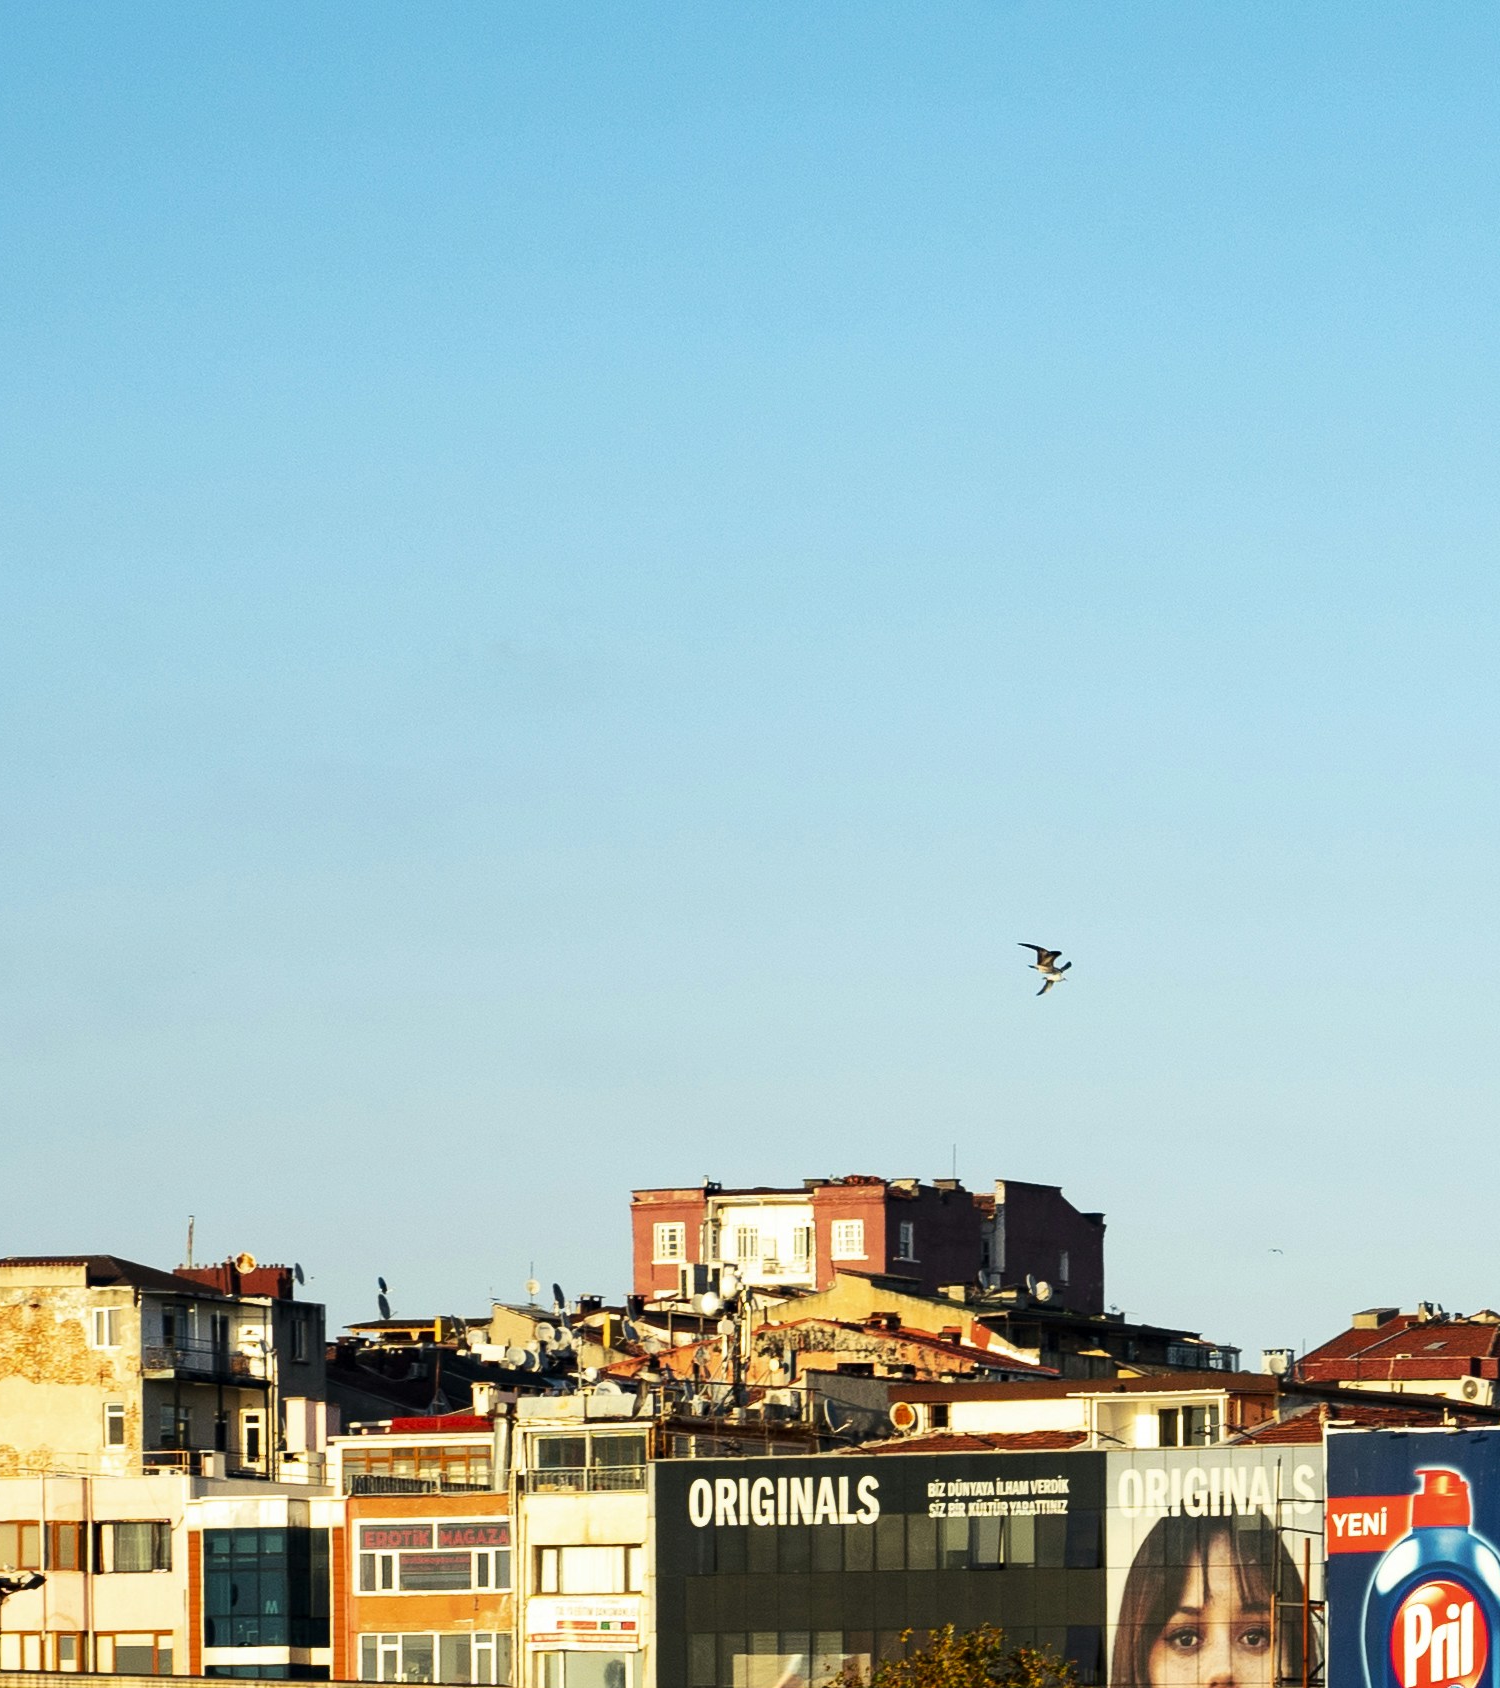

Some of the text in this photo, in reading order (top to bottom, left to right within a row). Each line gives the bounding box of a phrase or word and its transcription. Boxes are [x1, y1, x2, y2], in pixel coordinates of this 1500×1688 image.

[688, 1475, 880, 1527] ORIGINALS
[927, 1475, 1070, 1497] BİZ DÜNYAYA İLHAM VERDİK
[1118, 1464, 1316, 1518] ORIGINALS
[928, 1498, 1069, 1518] SİZ BİR KÜLTÜR YARATTINIZ
[1332, 1507, 1388, 1537] YENİ
[1403, 1601, 1475, 1688] Pril
